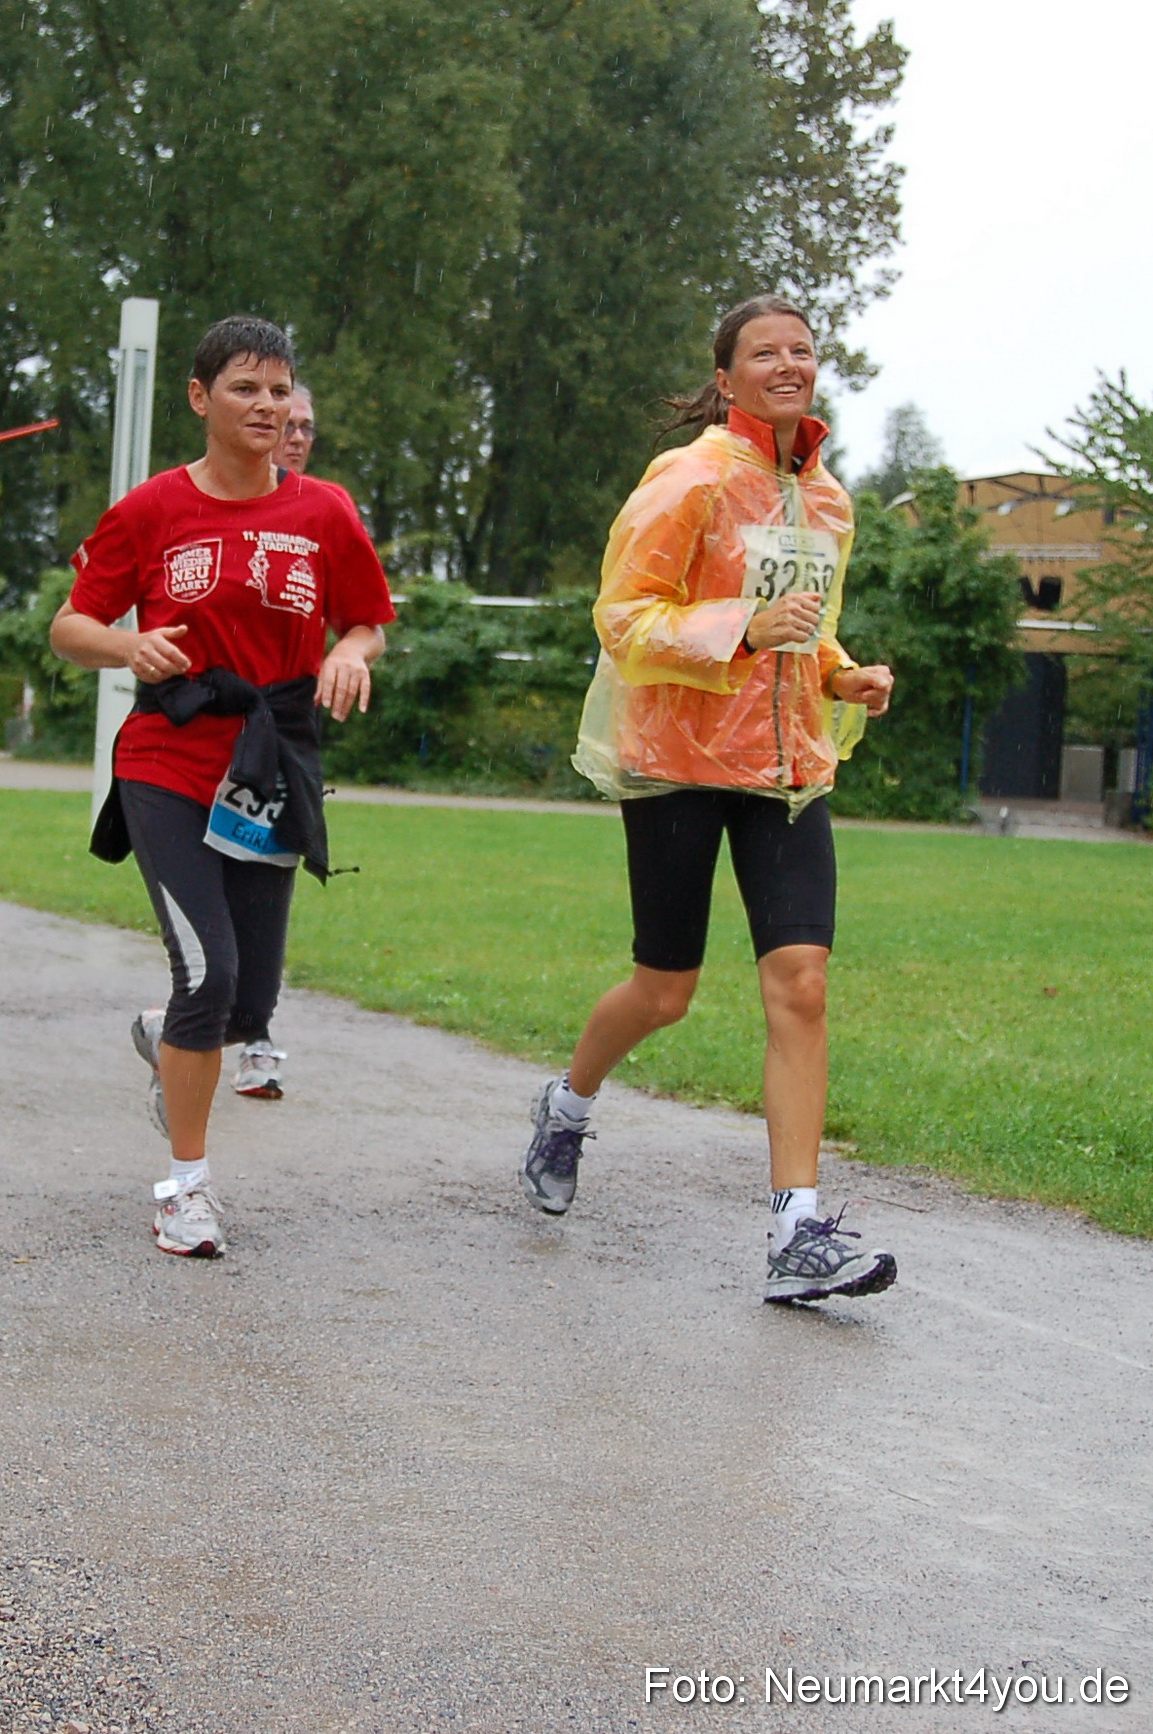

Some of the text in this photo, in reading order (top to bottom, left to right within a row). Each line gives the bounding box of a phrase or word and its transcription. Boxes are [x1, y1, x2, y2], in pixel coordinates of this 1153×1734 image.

[242, 530, 258, 542] 11.
[173, 547, 211, 563] IMMER
[170, 557, 213, 571] WIEDER
[171, 566, 210, 584] NEU
[171, 579, 209, 595] MARKT
